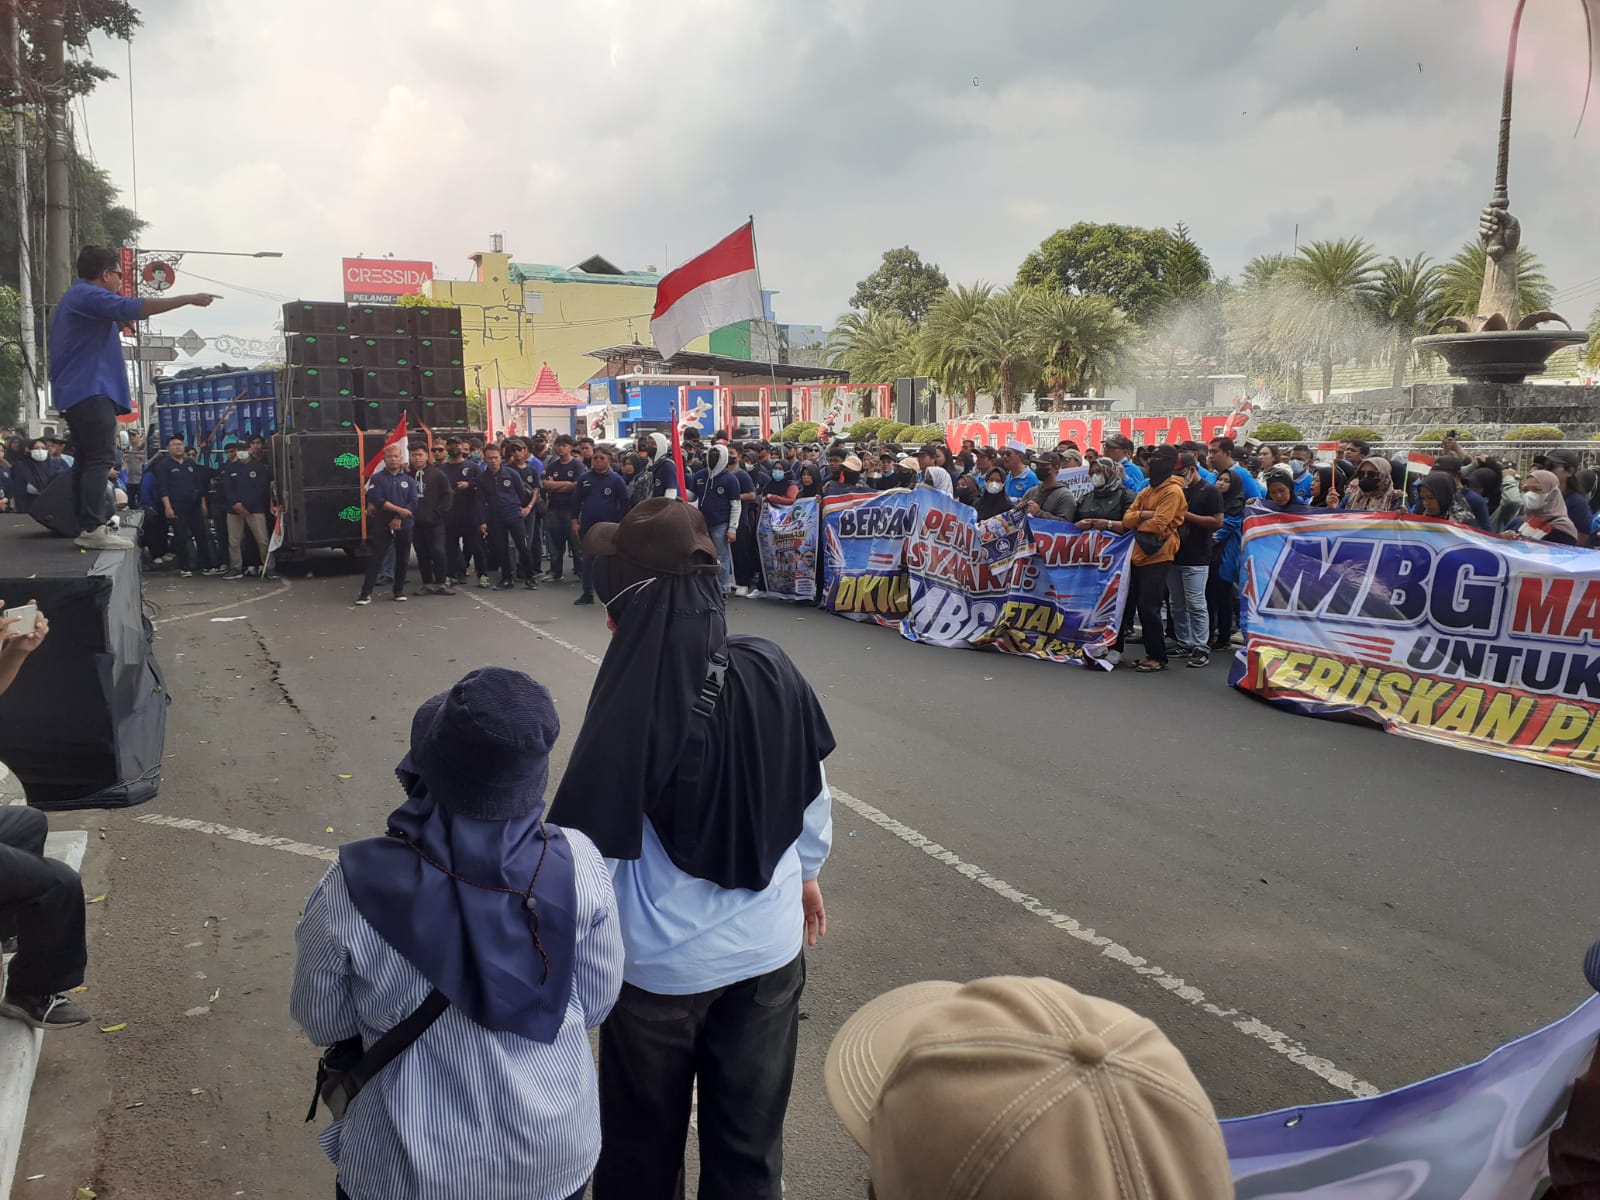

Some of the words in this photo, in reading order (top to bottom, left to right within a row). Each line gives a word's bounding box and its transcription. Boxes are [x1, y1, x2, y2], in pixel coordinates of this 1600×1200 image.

[347, 267, 429, 285] CRESSIDA
[1260, 536, 1507, 636] MBG
[1254, 645, 1537, 745] TERUSKAN
[1407, 636, 1600, 699] UNTUK
